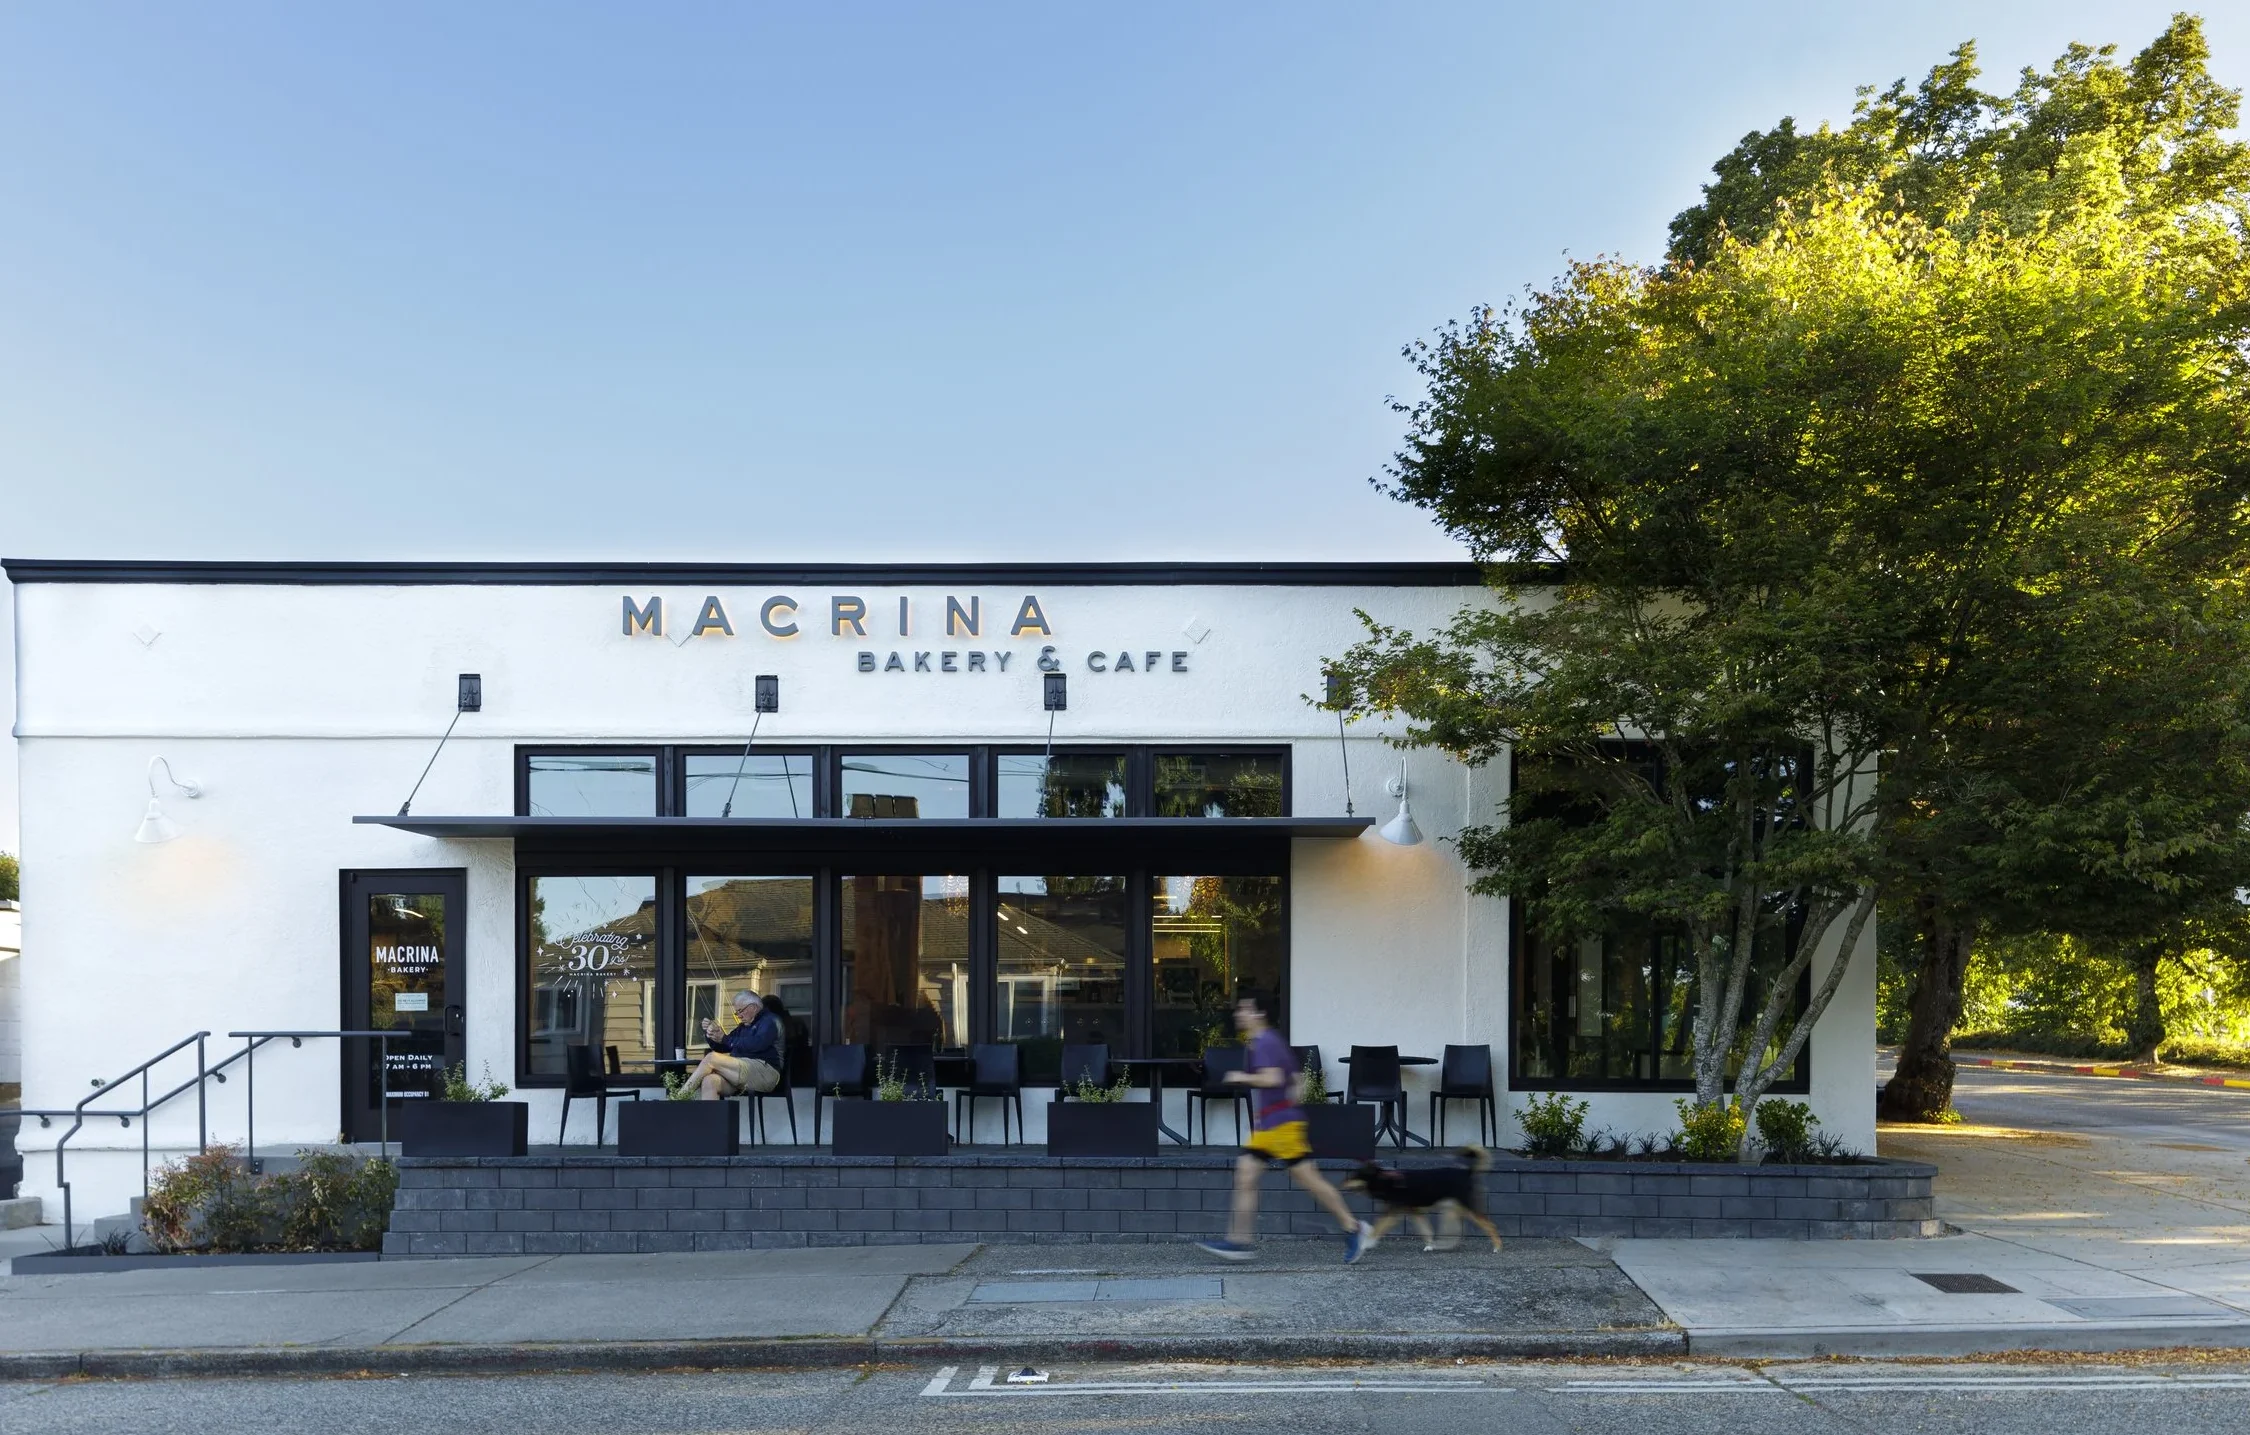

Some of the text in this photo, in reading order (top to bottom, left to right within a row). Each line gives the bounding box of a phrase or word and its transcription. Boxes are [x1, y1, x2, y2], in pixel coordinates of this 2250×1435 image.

[622, 594, 1052, 637] MACRINA
[857, 645, 1189, 672] BAKERY & CAFE
[555, 930, 629, 951] Celebrating
[376, 946, 439, 963] MACRINA
[568, 944, 631, 971] 30 yrs!
